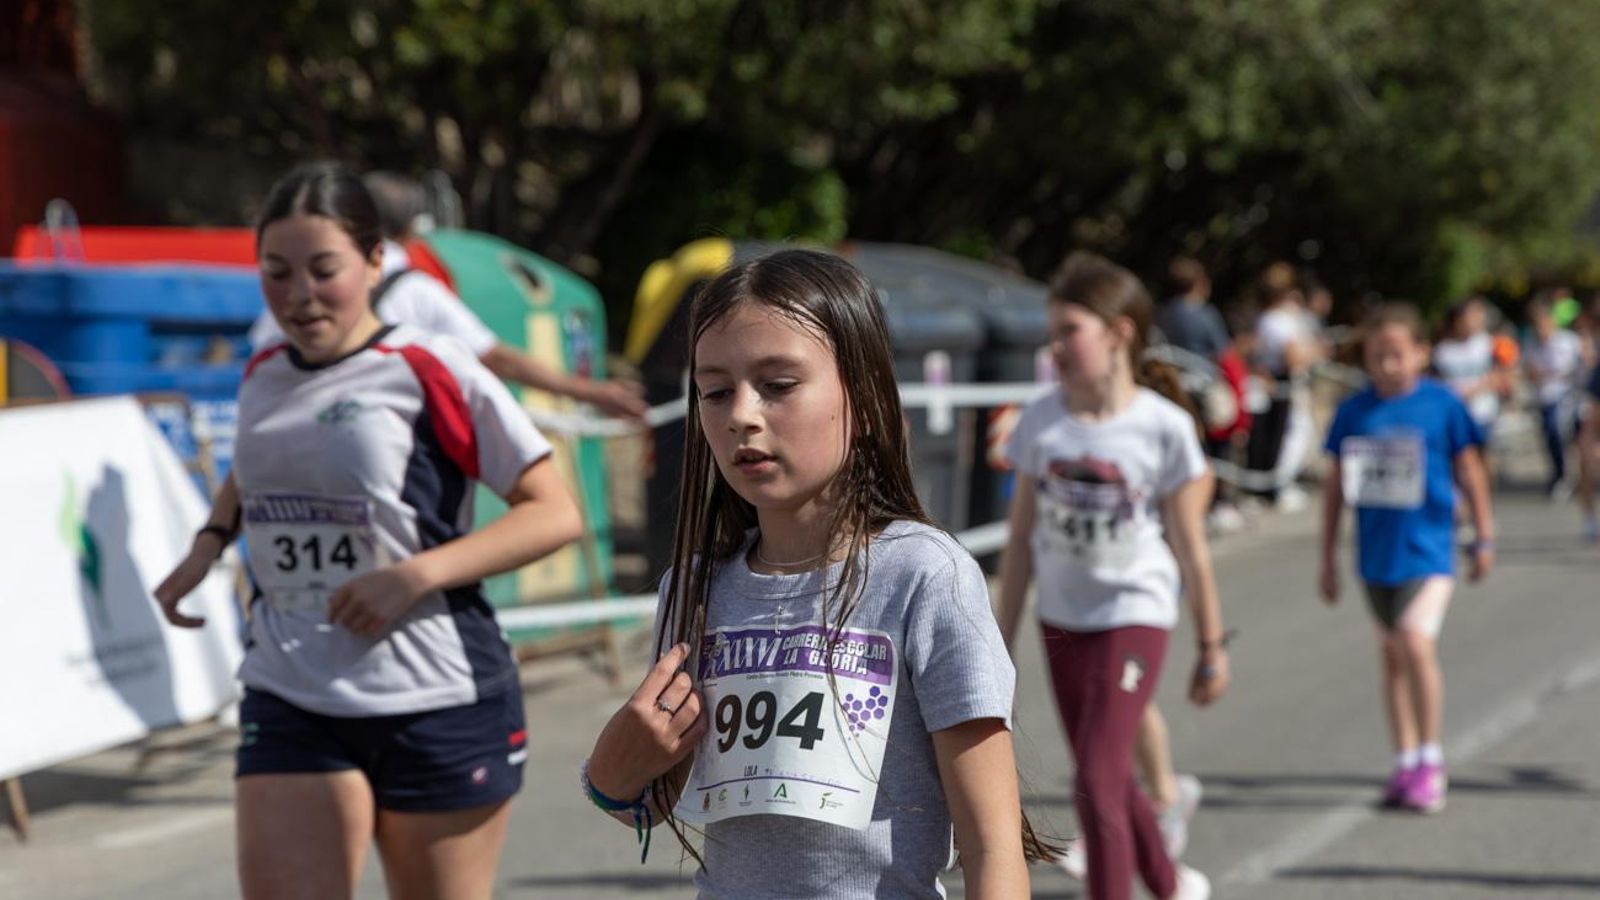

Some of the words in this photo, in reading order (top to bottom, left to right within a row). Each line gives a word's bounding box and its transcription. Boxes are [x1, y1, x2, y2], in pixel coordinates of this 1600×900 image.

[273, 533, 358, 571] 314
[782, 633, 829, 651] CARRERA
[833, 640, 887, 660] ESCOLAR
[783, 649, 799, 665] LA
[808, 649, 868, 675] GLORIA
[715, 690, 825, 754] 994
